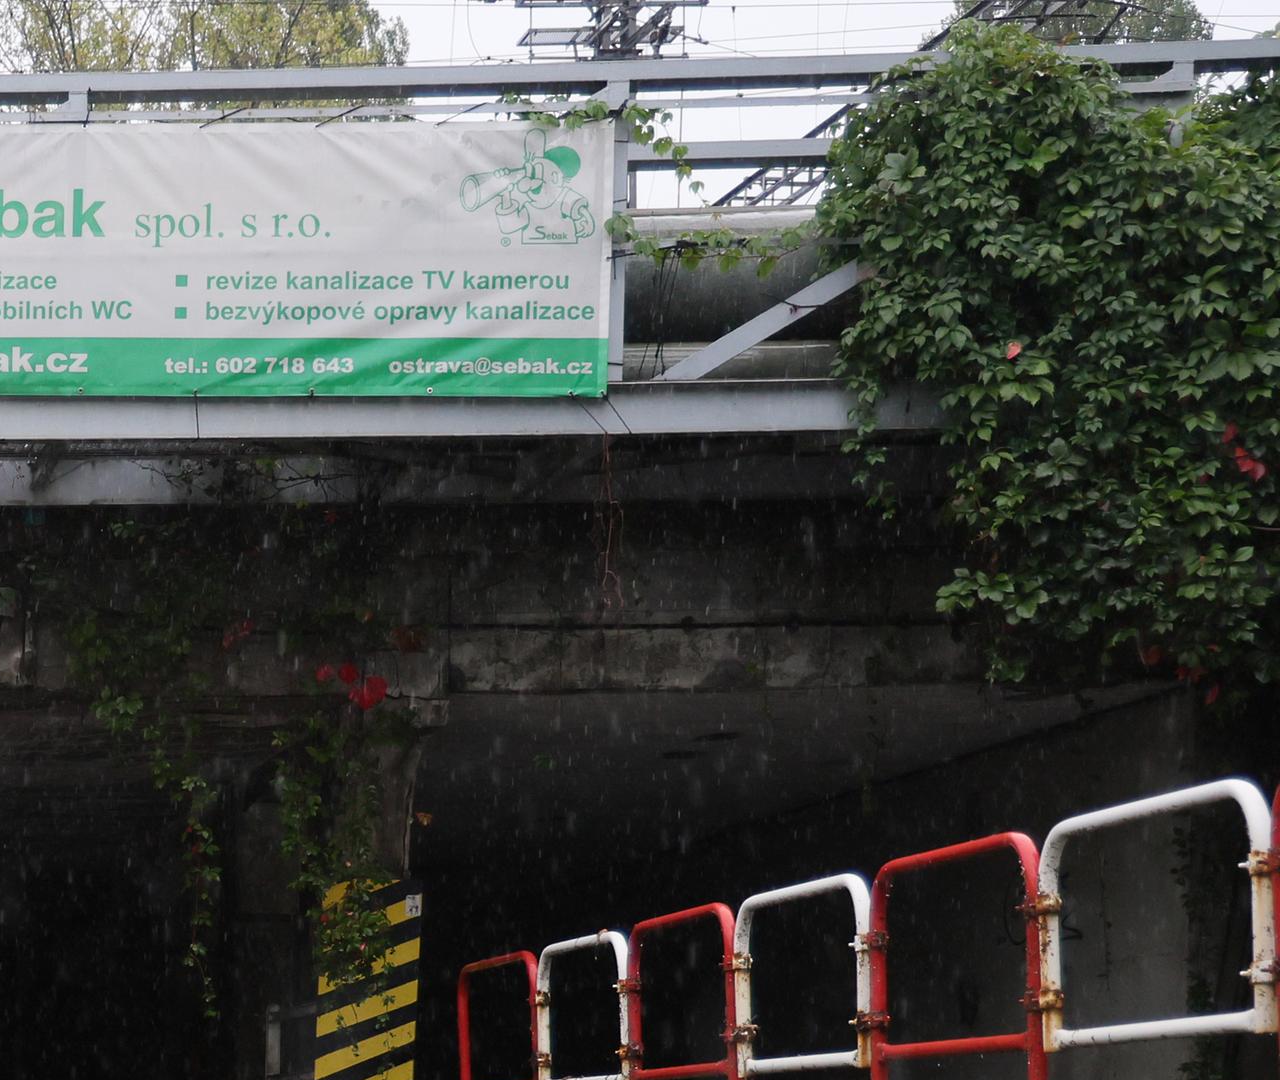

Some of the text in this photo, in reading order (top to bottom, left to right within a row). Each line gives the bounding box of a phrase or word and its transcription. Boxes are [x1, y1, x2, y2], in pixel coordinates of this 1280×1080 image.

[134, 203, 225, 248] spol.
[240, 211, 257, 239] s
[272, 211, 331, 239] r.o.
[529, 225, 569, 240] Sebak
[206, 270, 569, 290] revize kanalizace TV kamerou
[91, 300, 133, 320] WC
[205, 300, 595, 325] bezvýkopové opravy kanalizace
[164, 357, 354, 375] tel.: 602 718 643
[388, 357, 593, 377] ostrava@sebak.cz
